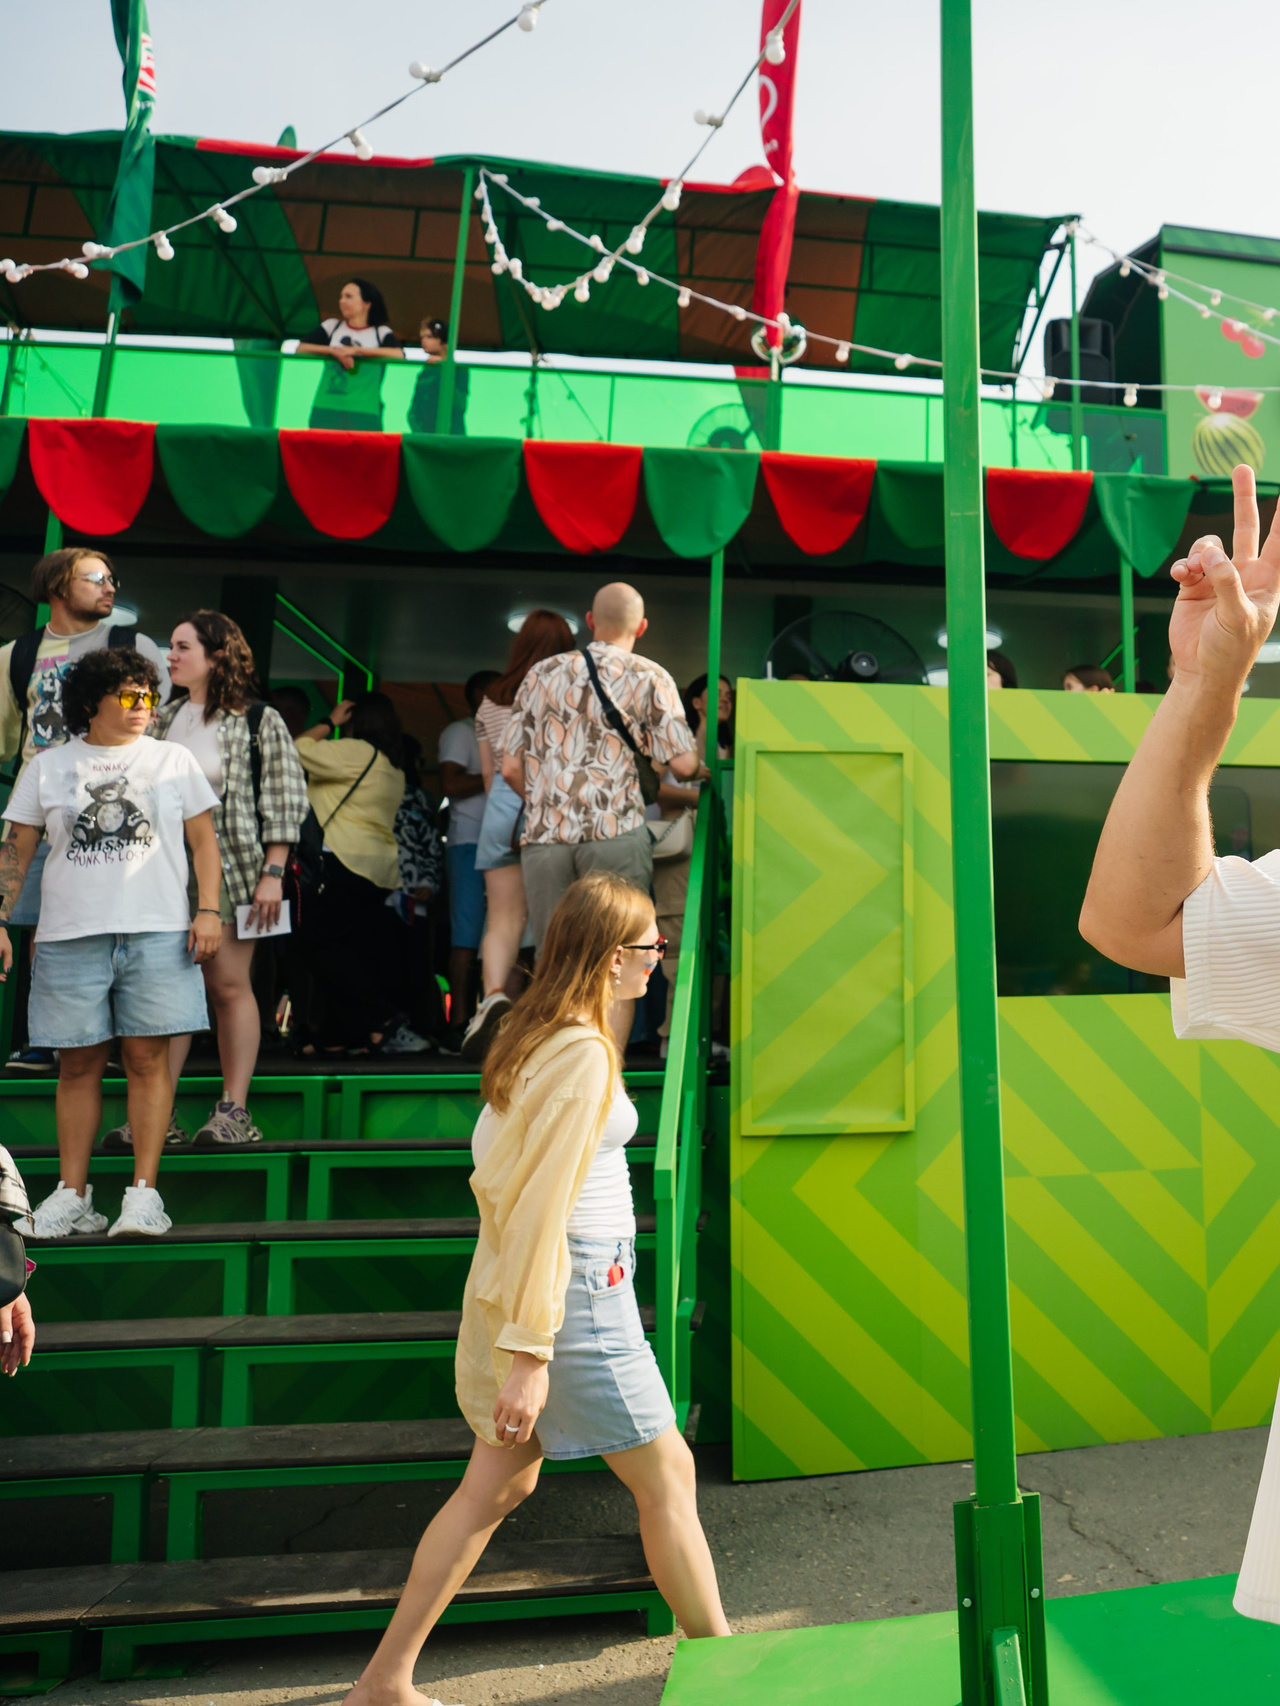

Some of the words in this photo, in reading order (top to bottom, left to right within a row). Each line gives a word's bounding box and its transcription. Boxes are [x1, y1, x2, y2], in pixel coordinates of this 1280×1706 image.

[74, 851, 100, 868] PUNK
[104, 851, 114, 863] IS
[119, 849, 146, 862] LOST
